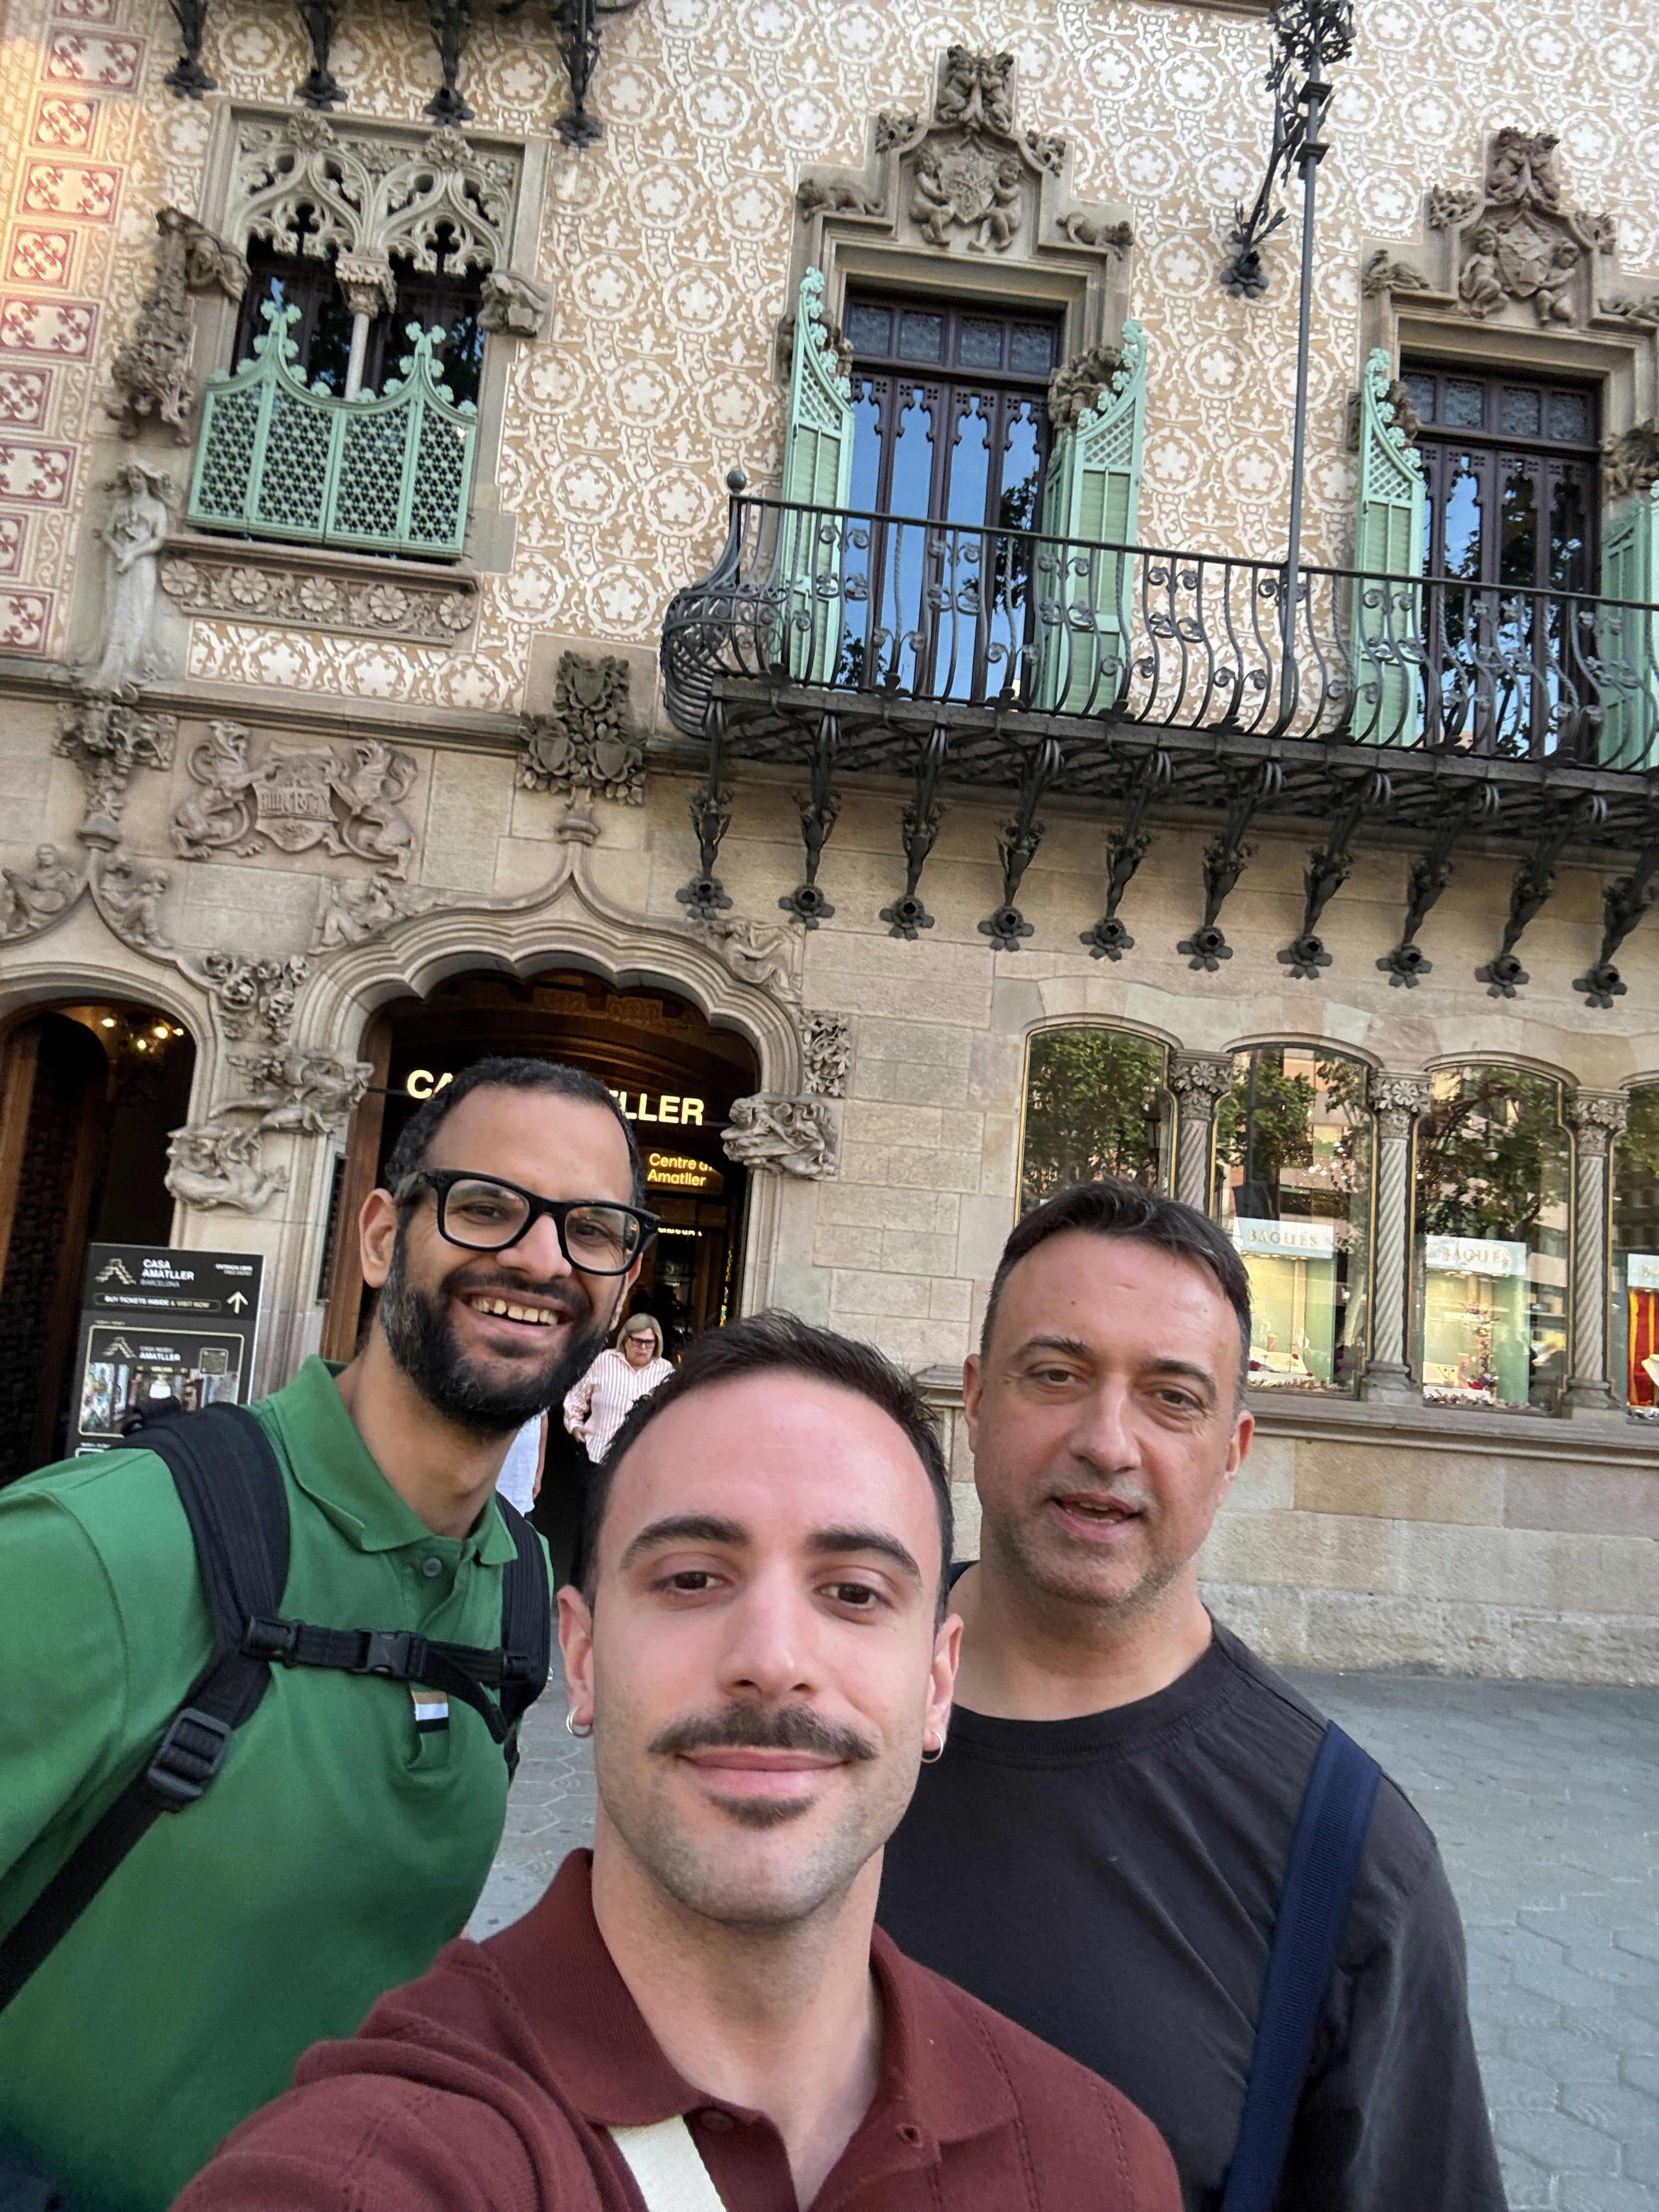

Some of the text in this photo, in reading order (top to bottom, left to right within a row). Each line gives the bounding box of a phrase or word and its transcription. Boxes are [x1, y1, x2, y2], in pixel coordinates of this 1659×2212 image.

[609, 1090, 704, 1126] LLER
[650, 1153, 696, 1170] Centre
[647, 1169, 707, 1186] Amatller
[143, 1259, 171, 1269] CASA
[142, 1268, 195, 1281] AMATLLER
